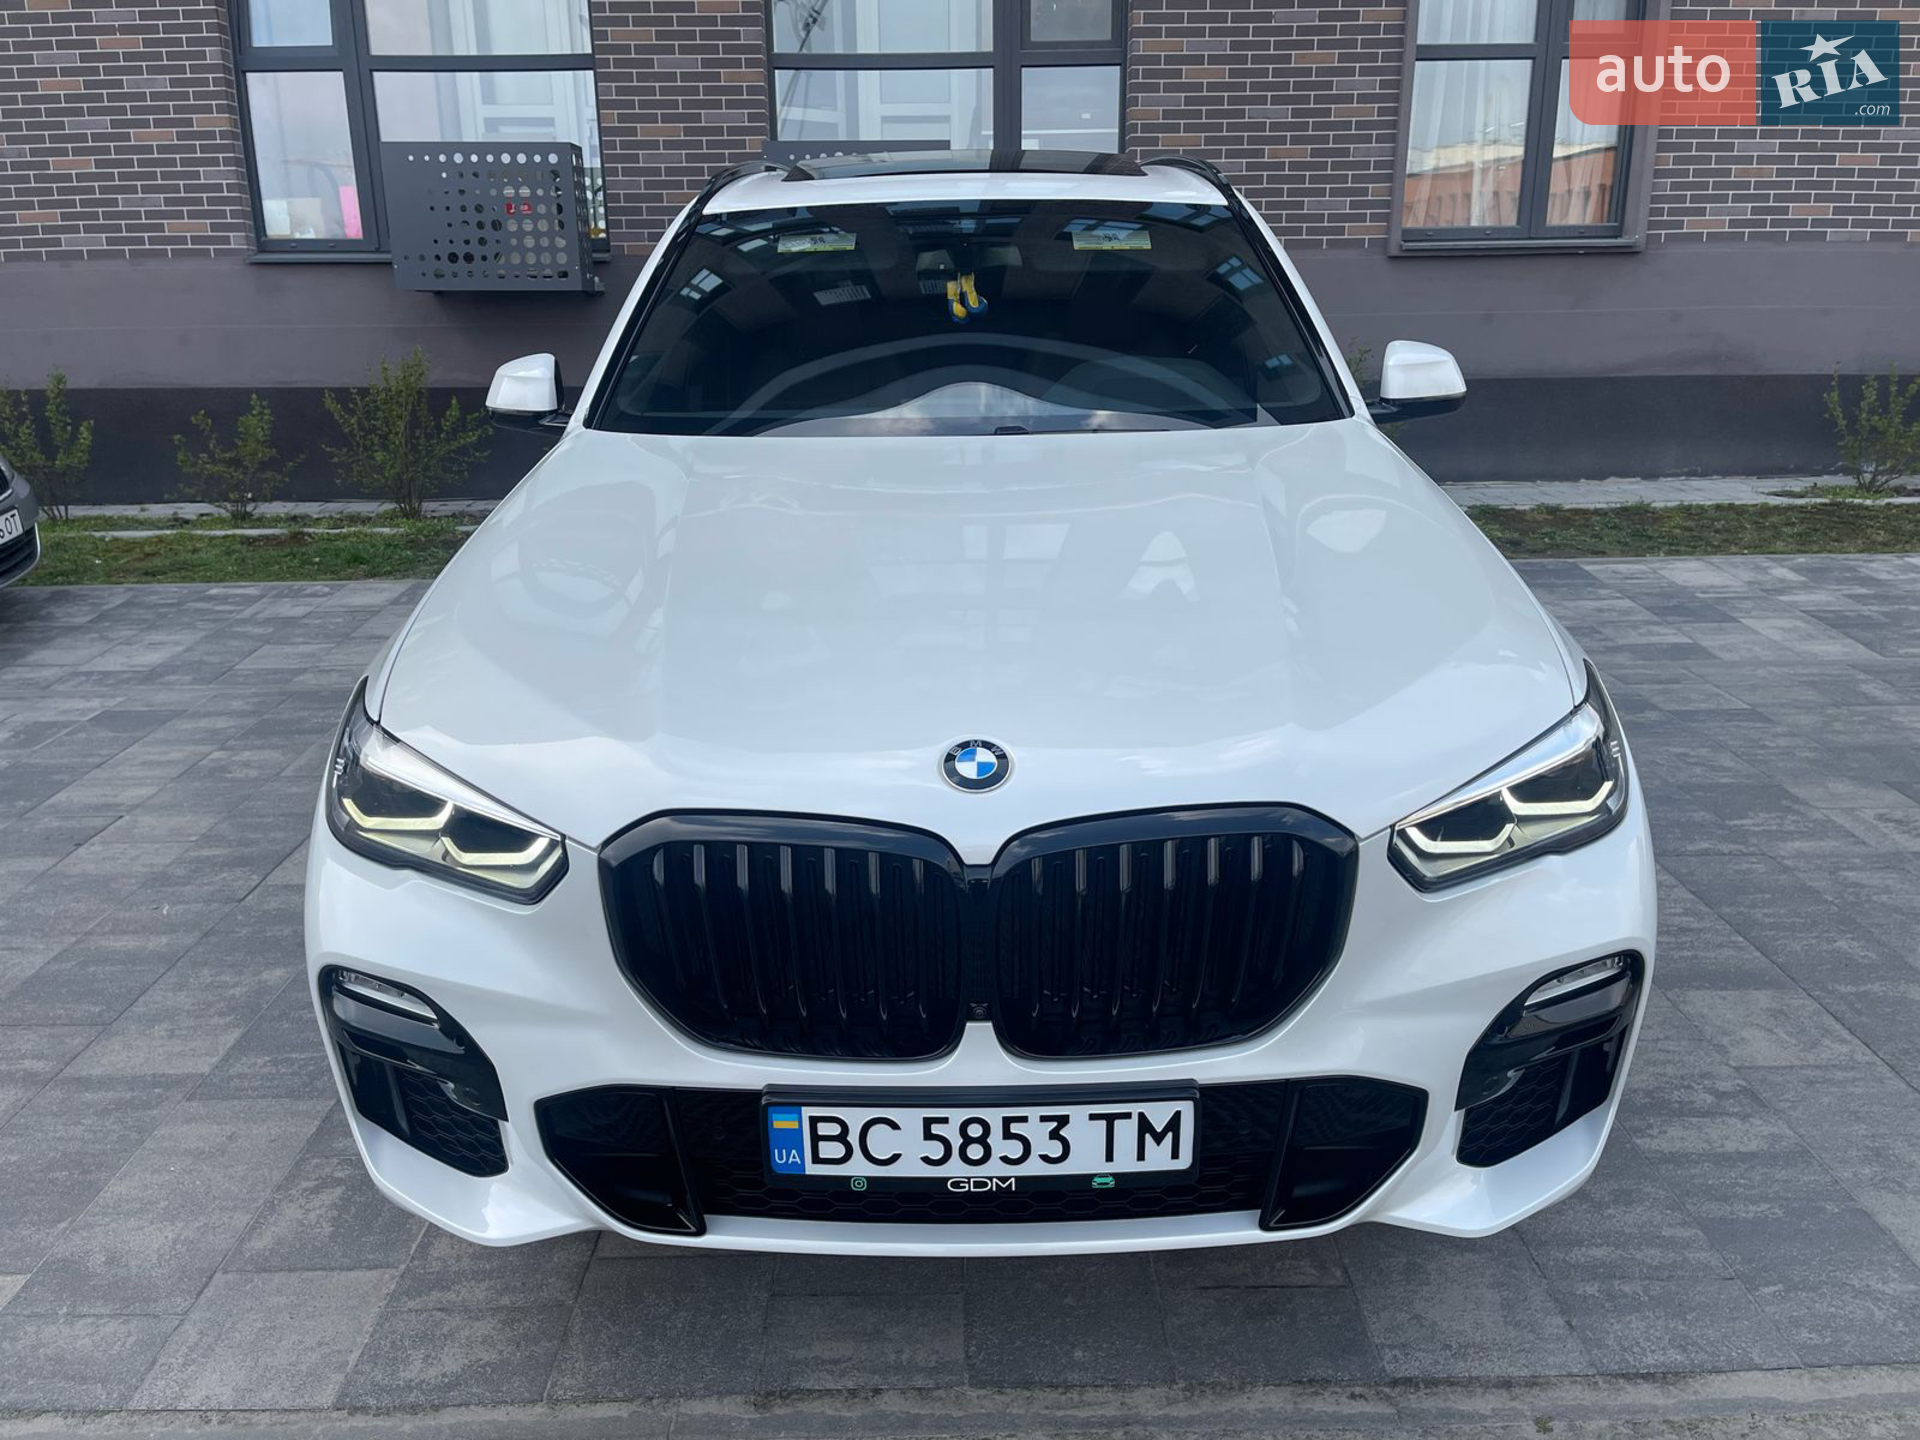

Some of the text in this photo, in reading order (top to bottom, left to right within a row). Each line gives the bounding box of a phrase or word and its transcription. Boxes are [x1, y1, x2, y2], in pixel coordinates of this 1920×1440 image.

[949, 740, 1004, 756] BMW
[808, 1109, 1182, 1167] BC 5853 TM
[774, 1148, 801, 1165] UA
[946, 1176, 1016, 1193] GDM
